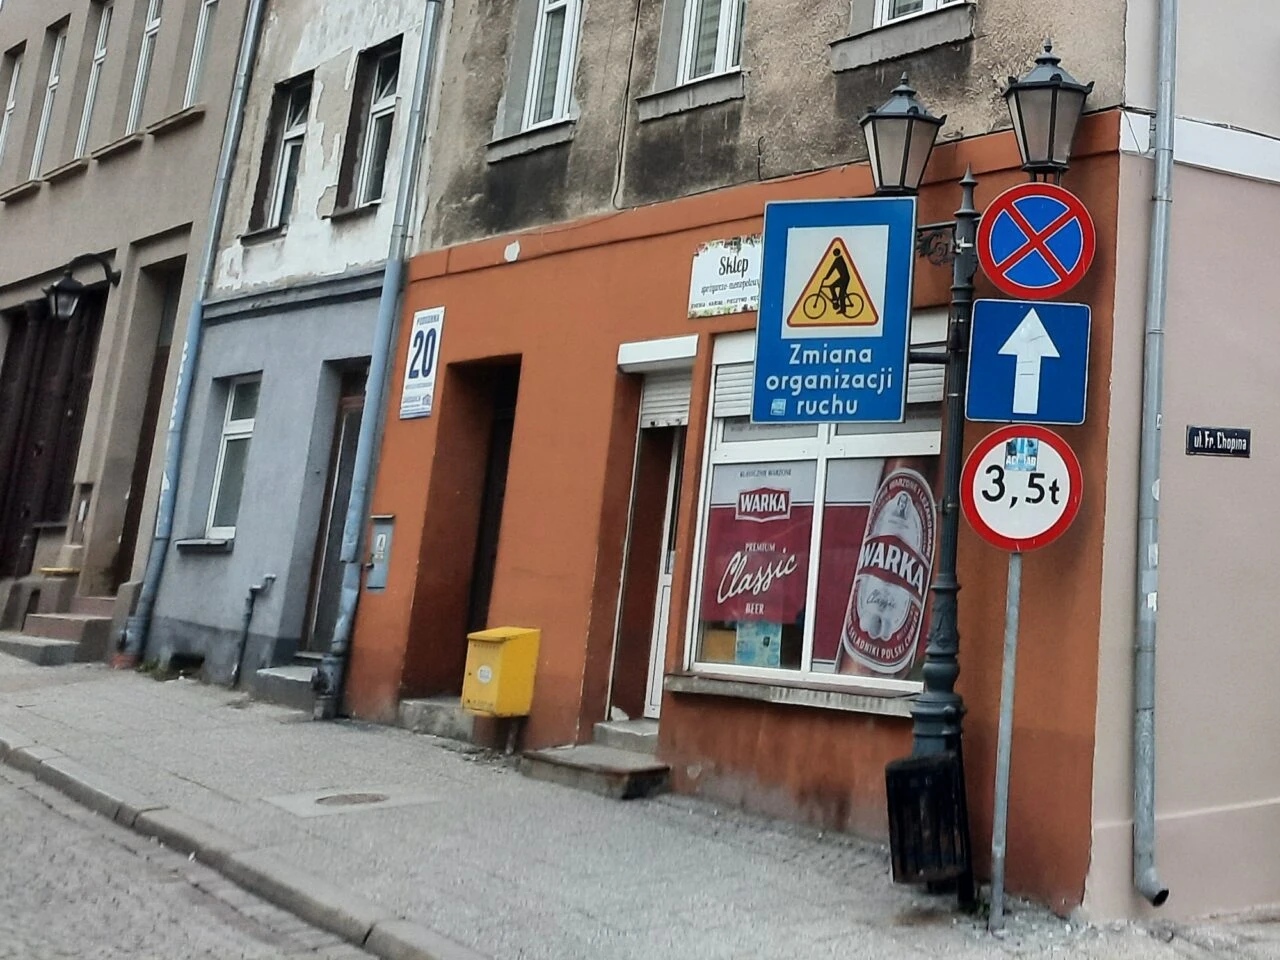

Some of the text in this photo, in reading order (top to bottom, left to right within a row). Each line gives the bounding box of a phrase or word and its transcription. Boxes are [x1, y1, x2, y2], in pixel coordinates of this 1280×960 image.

[719, 256, 749, 278] Sklep
[408, 328, 436, 378] 20
[789, 343, 872, 365] Zmiana
[766, 367, 893, 396] organizacji
[797, 393, 858, 415] ruchu
[1205, 431, 1215, 449] Fr.
[1217, 432, 1247, 453] Chopina
[982, 464, 1060, 509] 3,5t
[740, 493, 787, 512] WARKA
[745, 542, 776, 553] PREMIUM
[717, 547, 798, 604] Classic
[860, 542, 924, 597] WARKA
[745, 603, 764, 615] BEER
[881, 644, 905, 659] POLSKI
